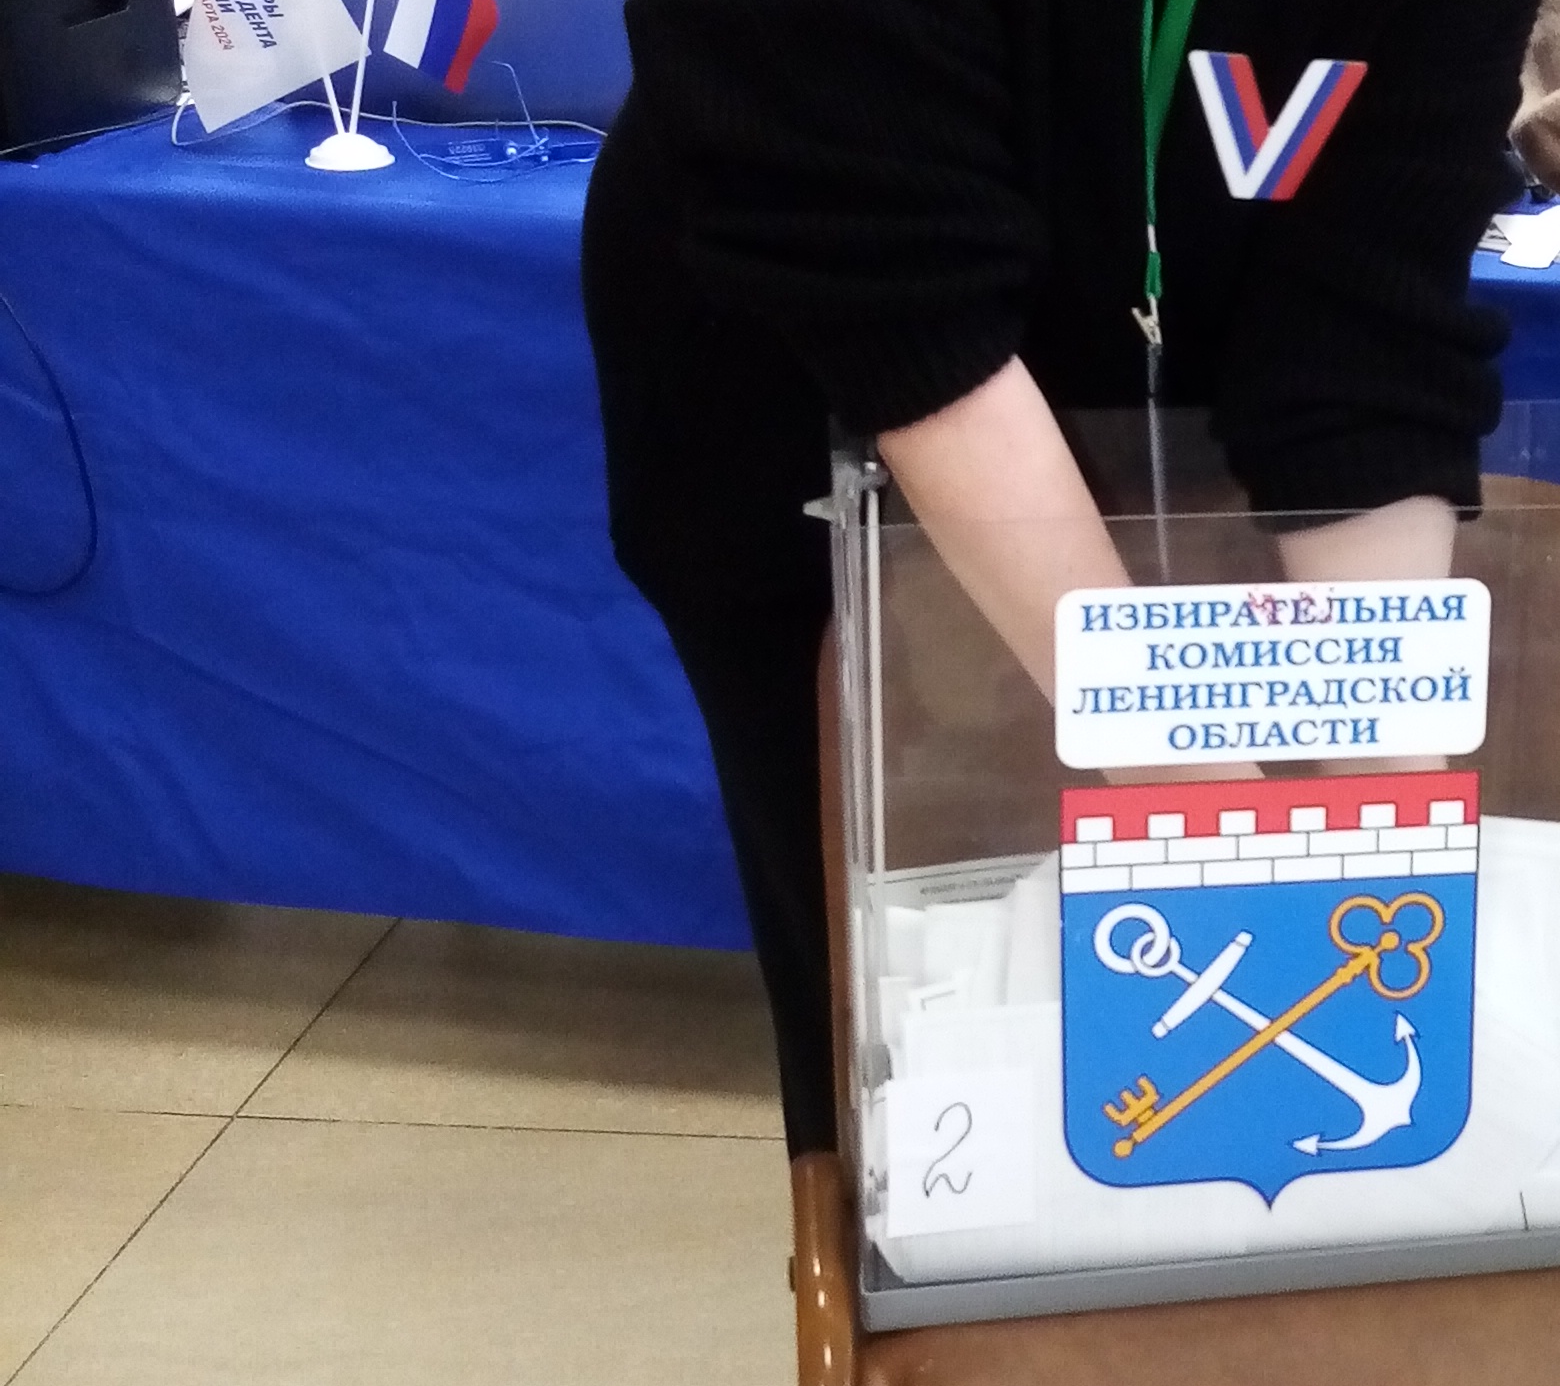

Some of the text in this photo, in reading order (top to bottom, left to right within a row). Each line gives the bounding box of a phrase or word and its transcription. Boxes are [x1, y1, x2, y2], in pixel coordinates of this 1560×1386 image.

[212, 24, 235, 51] 2024
[1081, 592, 1468, 633] ИЗБИРАТЕЛЬНАЯ
[1146, 635, 1403, 672] КОМИССИЯ
[1073, 665, 1472, 716] ЛЕНИНГРАДСКОЙ
[1168, 716, 1380, 751] ОБЛАСТИ
[922, 1101, 973, 1198] 2
